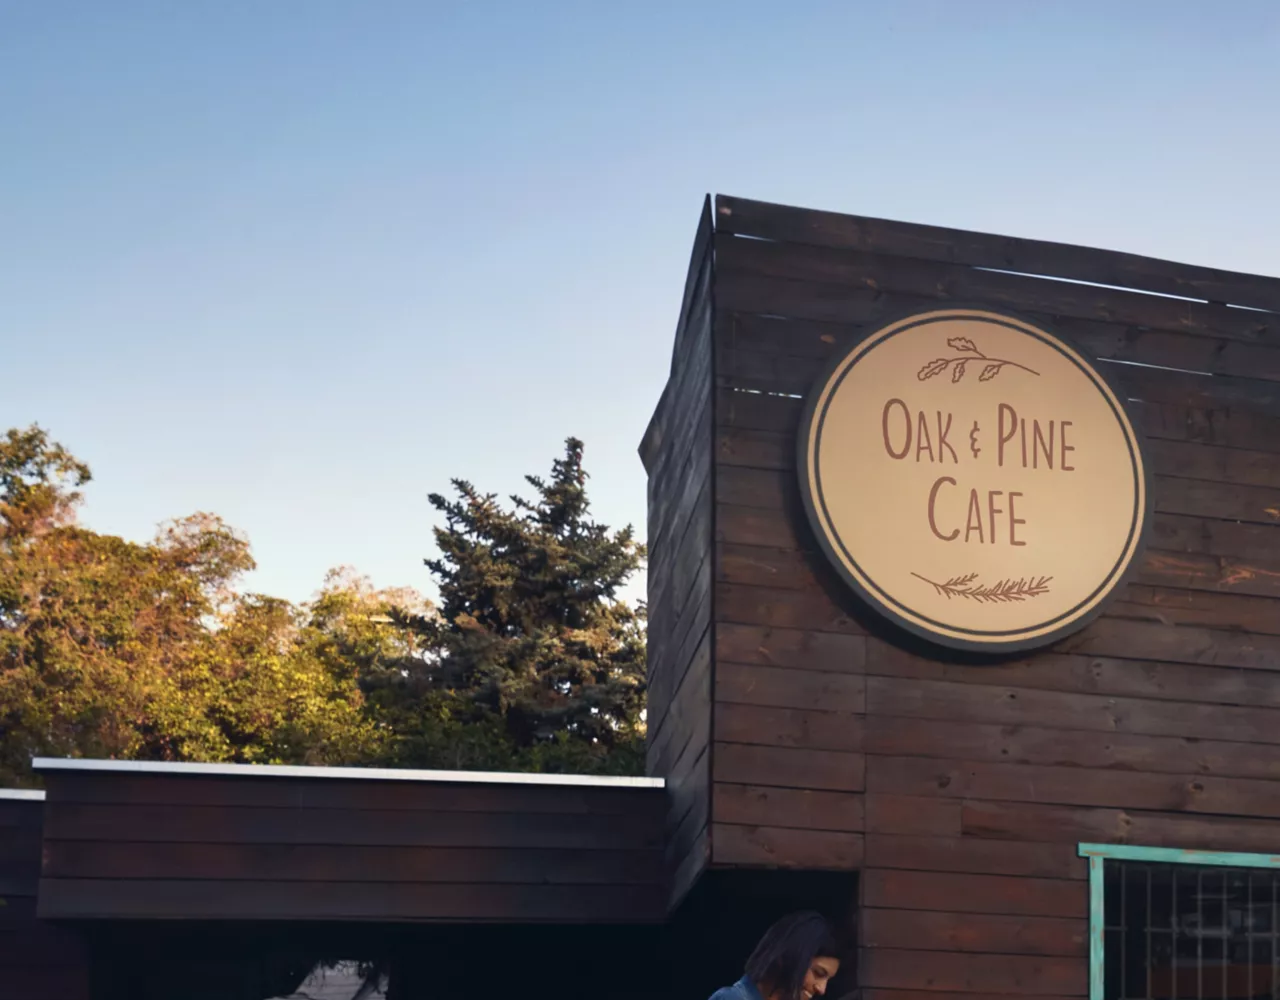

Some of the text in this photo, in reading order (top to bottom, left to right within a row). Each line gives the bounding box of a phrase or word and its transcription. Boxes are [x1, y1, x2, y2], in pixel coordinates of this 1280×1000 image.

[882, 398, 1075, 471] OAK & PINE
[928, 476, 1027, 546] CAFE
